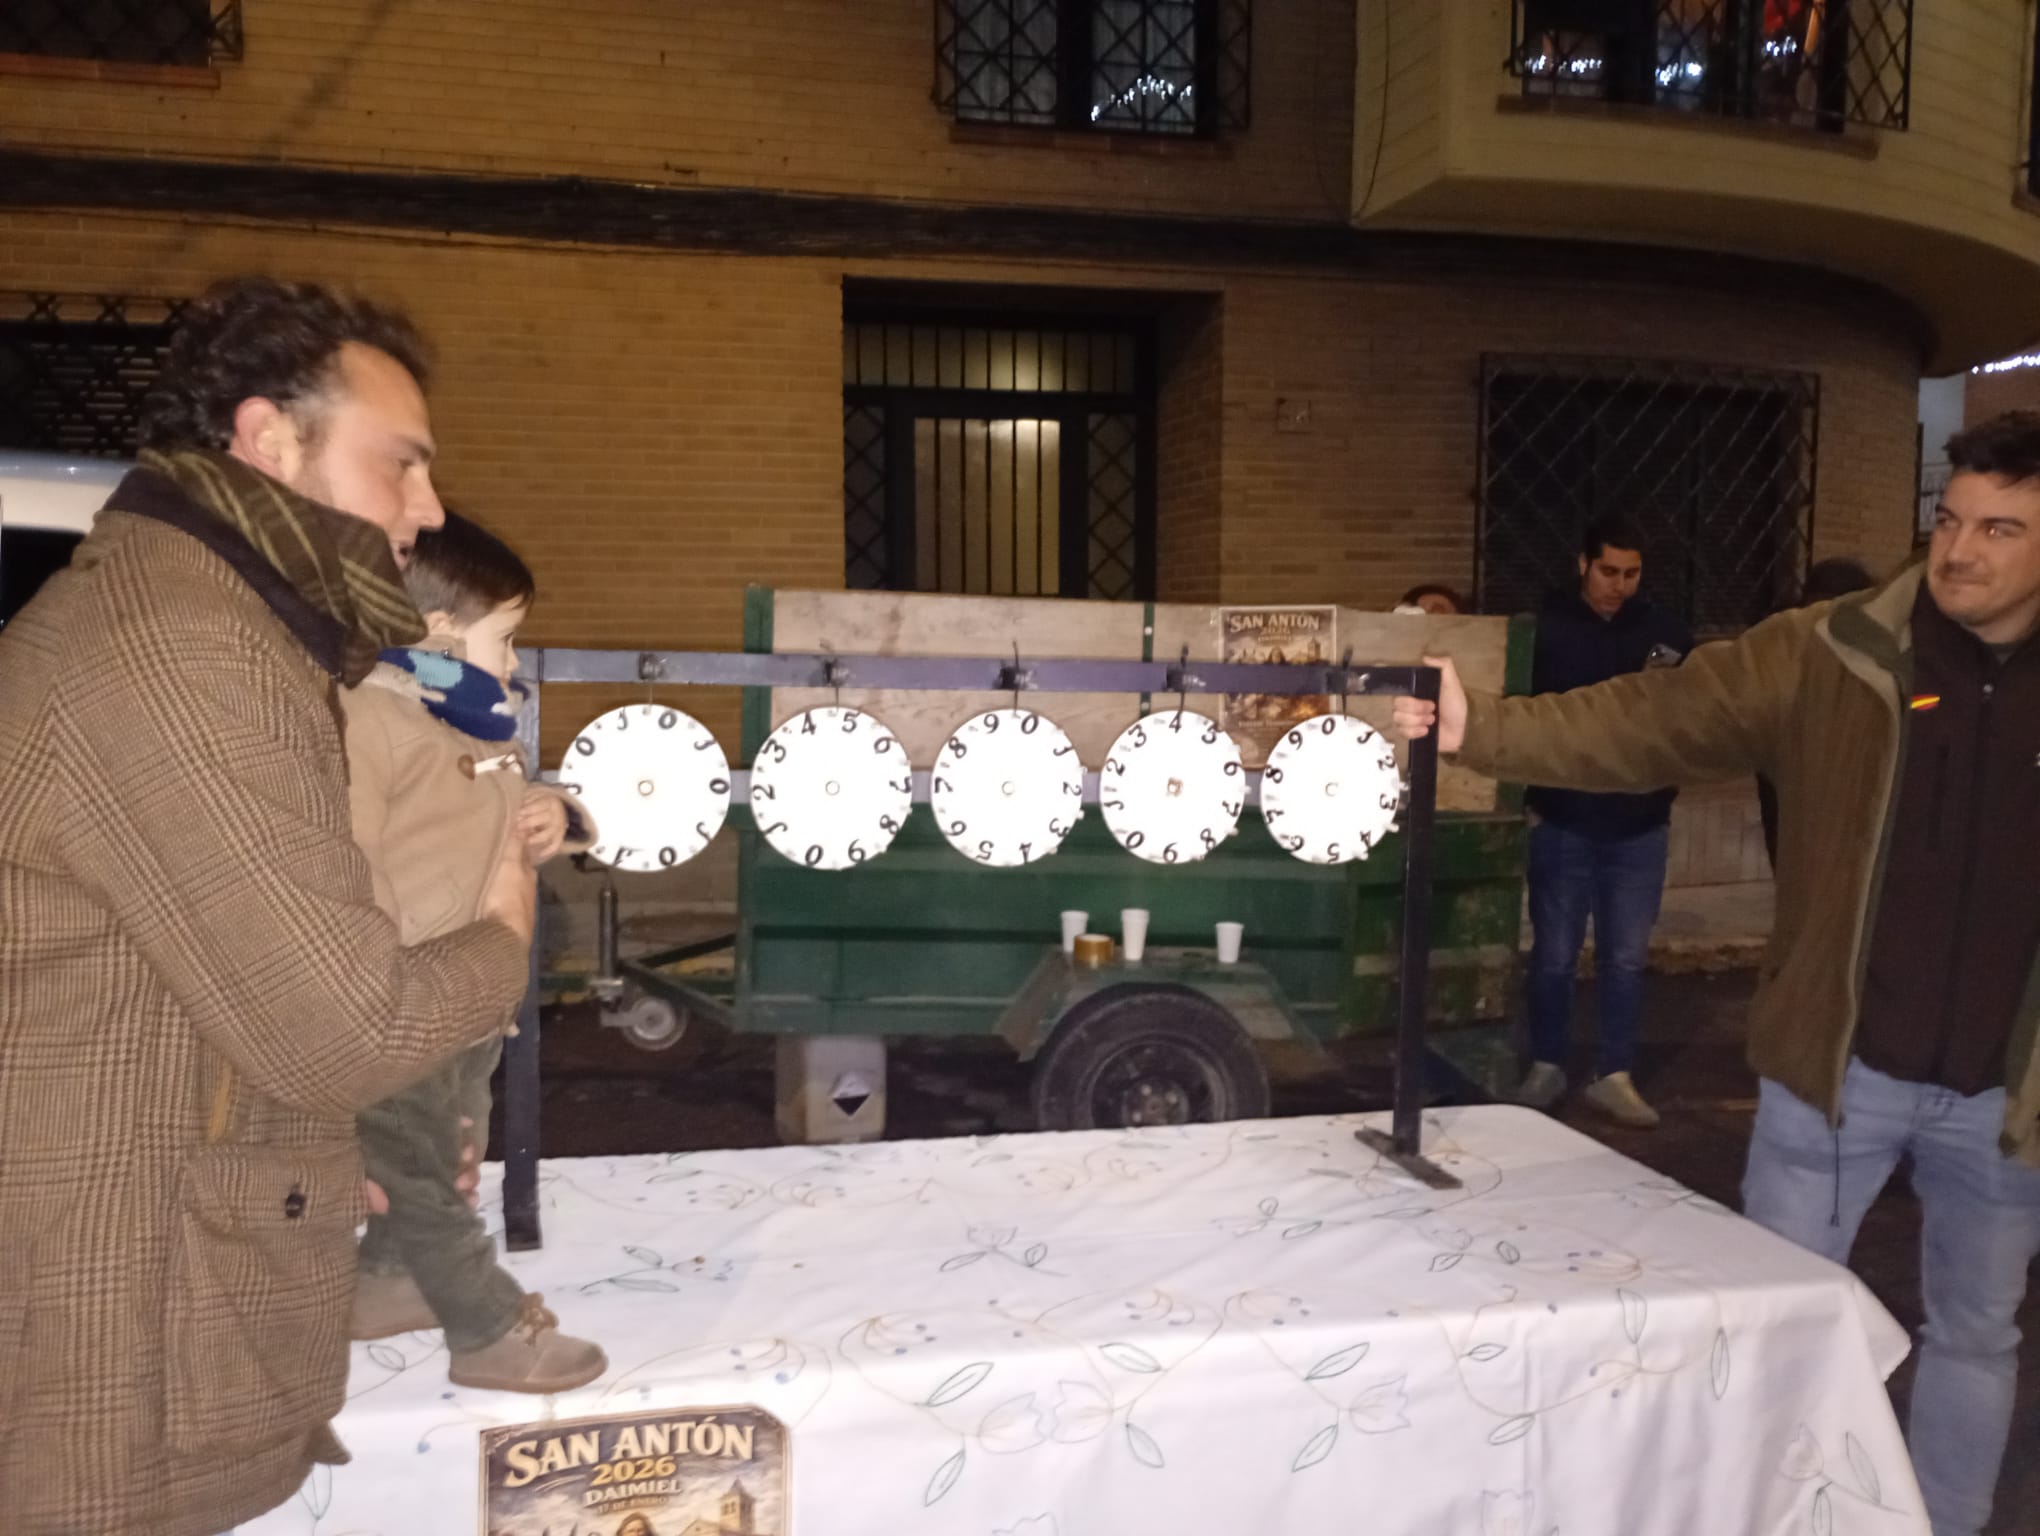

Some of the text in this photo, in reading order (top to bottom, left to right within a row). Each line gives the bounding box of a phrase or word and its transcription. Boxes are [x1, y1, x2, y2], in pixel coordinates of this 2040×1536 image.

[1230, 614, 1263, 632] SAN
[658, 711, 677, 729] 0
[1021, 714, 1039, 734] 0
[1321, 717, 1336, 735] 0
[576, 736, 595, 756] 0
[710, 778, 730, 794] 0
[1126, 831, 1145, 849] 0
[659, 846, 677, 866] 0
[805, 845, 824, 866] 0
[504, 1416, 755, 1488] SAN ANTÓN
[591, 1456, 677, 1486] 2026
[584, 1479, 683, 1506] DAIMIEL
